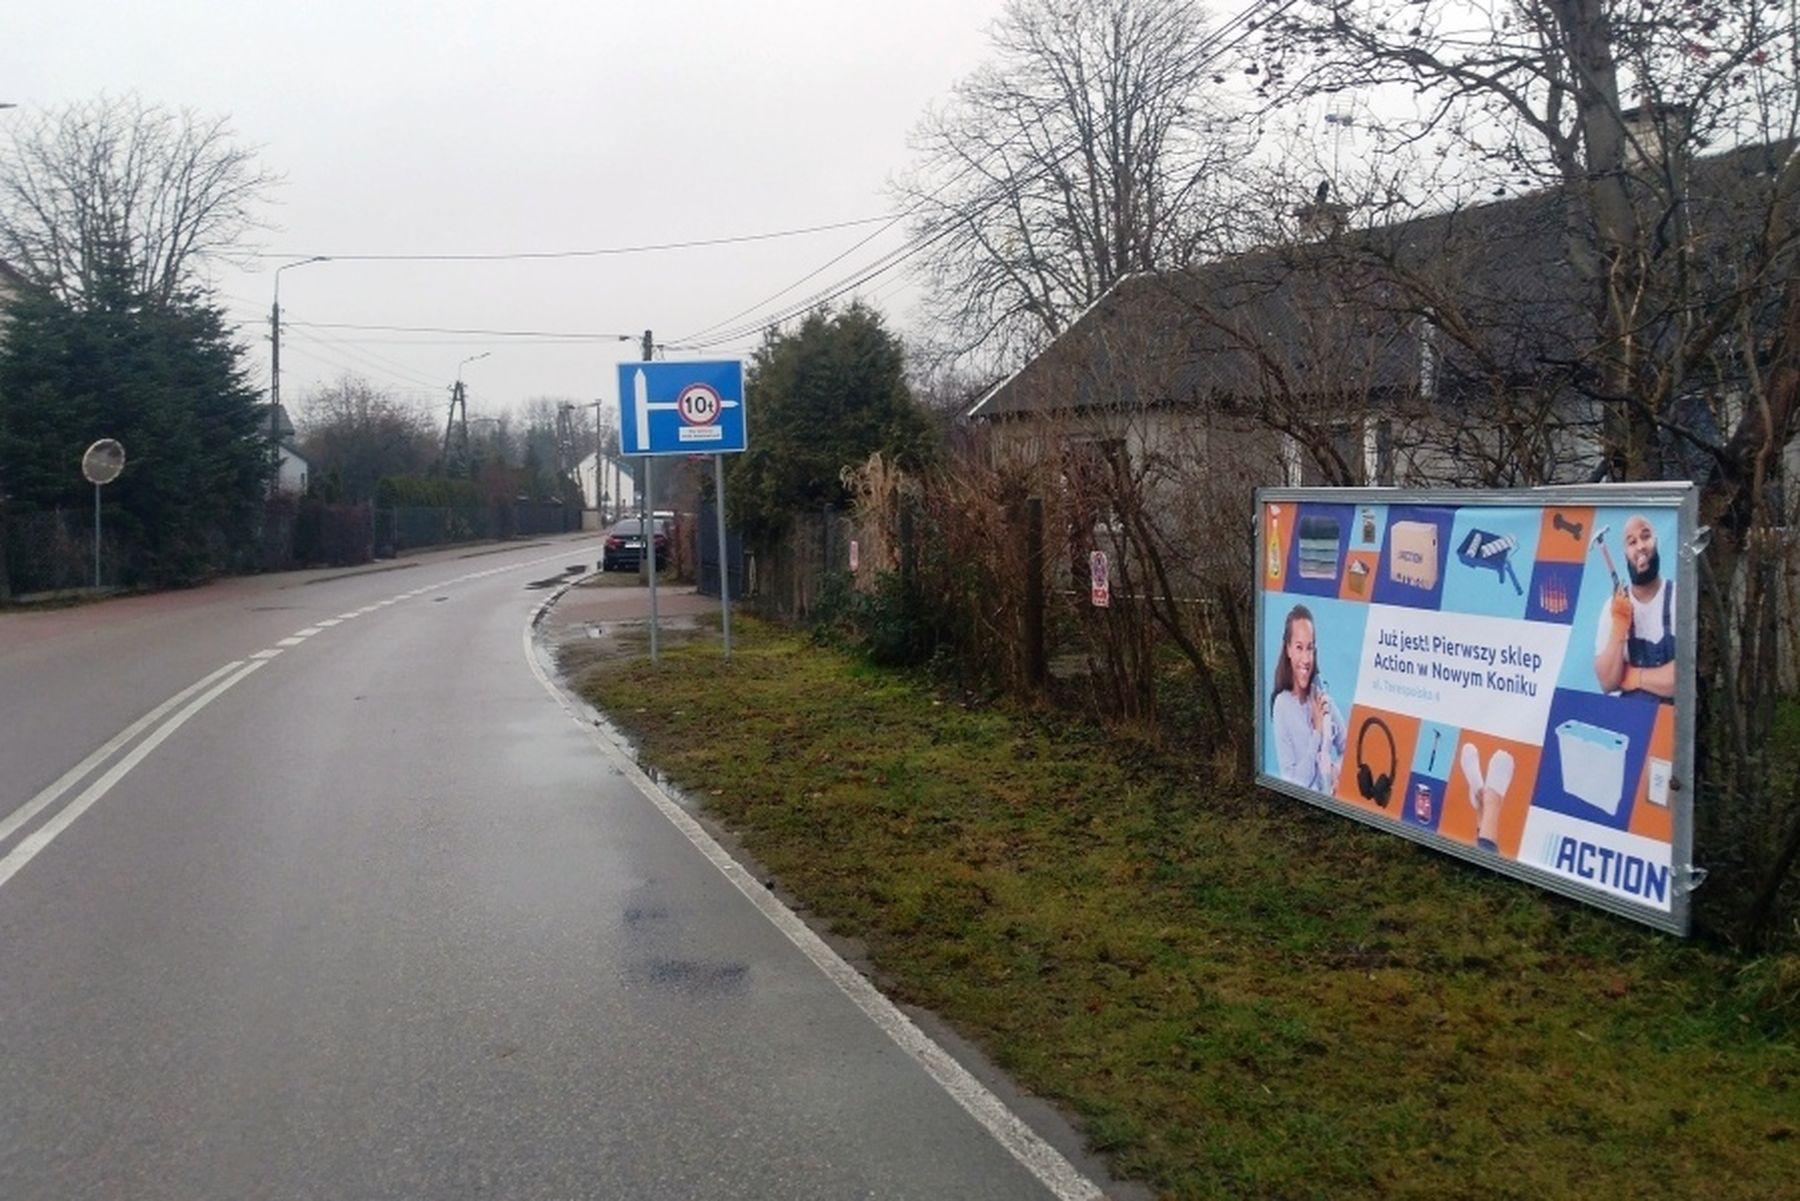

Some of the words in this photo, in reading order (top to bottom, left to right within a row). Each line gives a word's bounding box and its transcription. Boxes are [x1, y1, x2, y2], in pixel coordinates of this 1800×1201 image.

[1378, 629, 1397, 647] Już
[1400, 631, 1430, 652] jest!
[1432, 636, 1497, 666] Pierwszy
[1501, 645, 1542, 672] sklep
[1374, 653, 1414, 674] Action
[1416, 663, 1428, 676] w
[1432, 662, 1483, 688] Nowym
[1487, 671, 1538, 697] Koniku
[1556, 836, 1668, 903] ACTION
